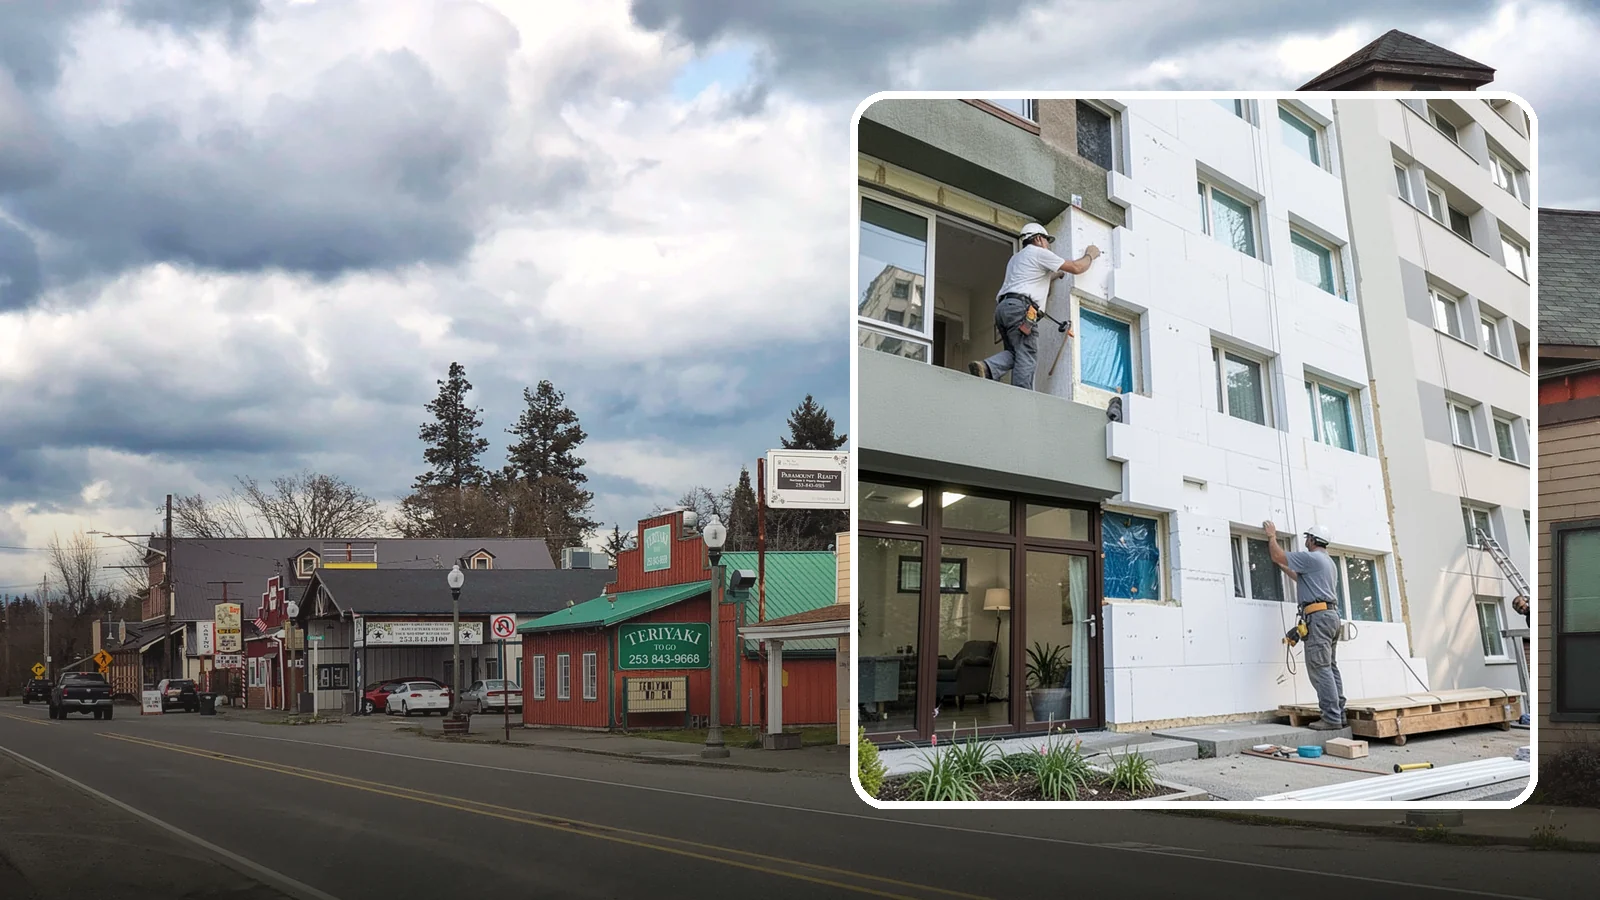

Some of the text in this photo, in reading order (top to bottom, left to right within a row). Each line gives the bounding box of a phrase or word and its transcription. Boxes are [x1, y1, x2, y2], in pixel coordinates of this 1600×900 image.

[817, 472, 839, 480] REALTY
[624, 627, 703, 646] TERIYAKI
[628, 653, 700, 665] 253 843-9668
